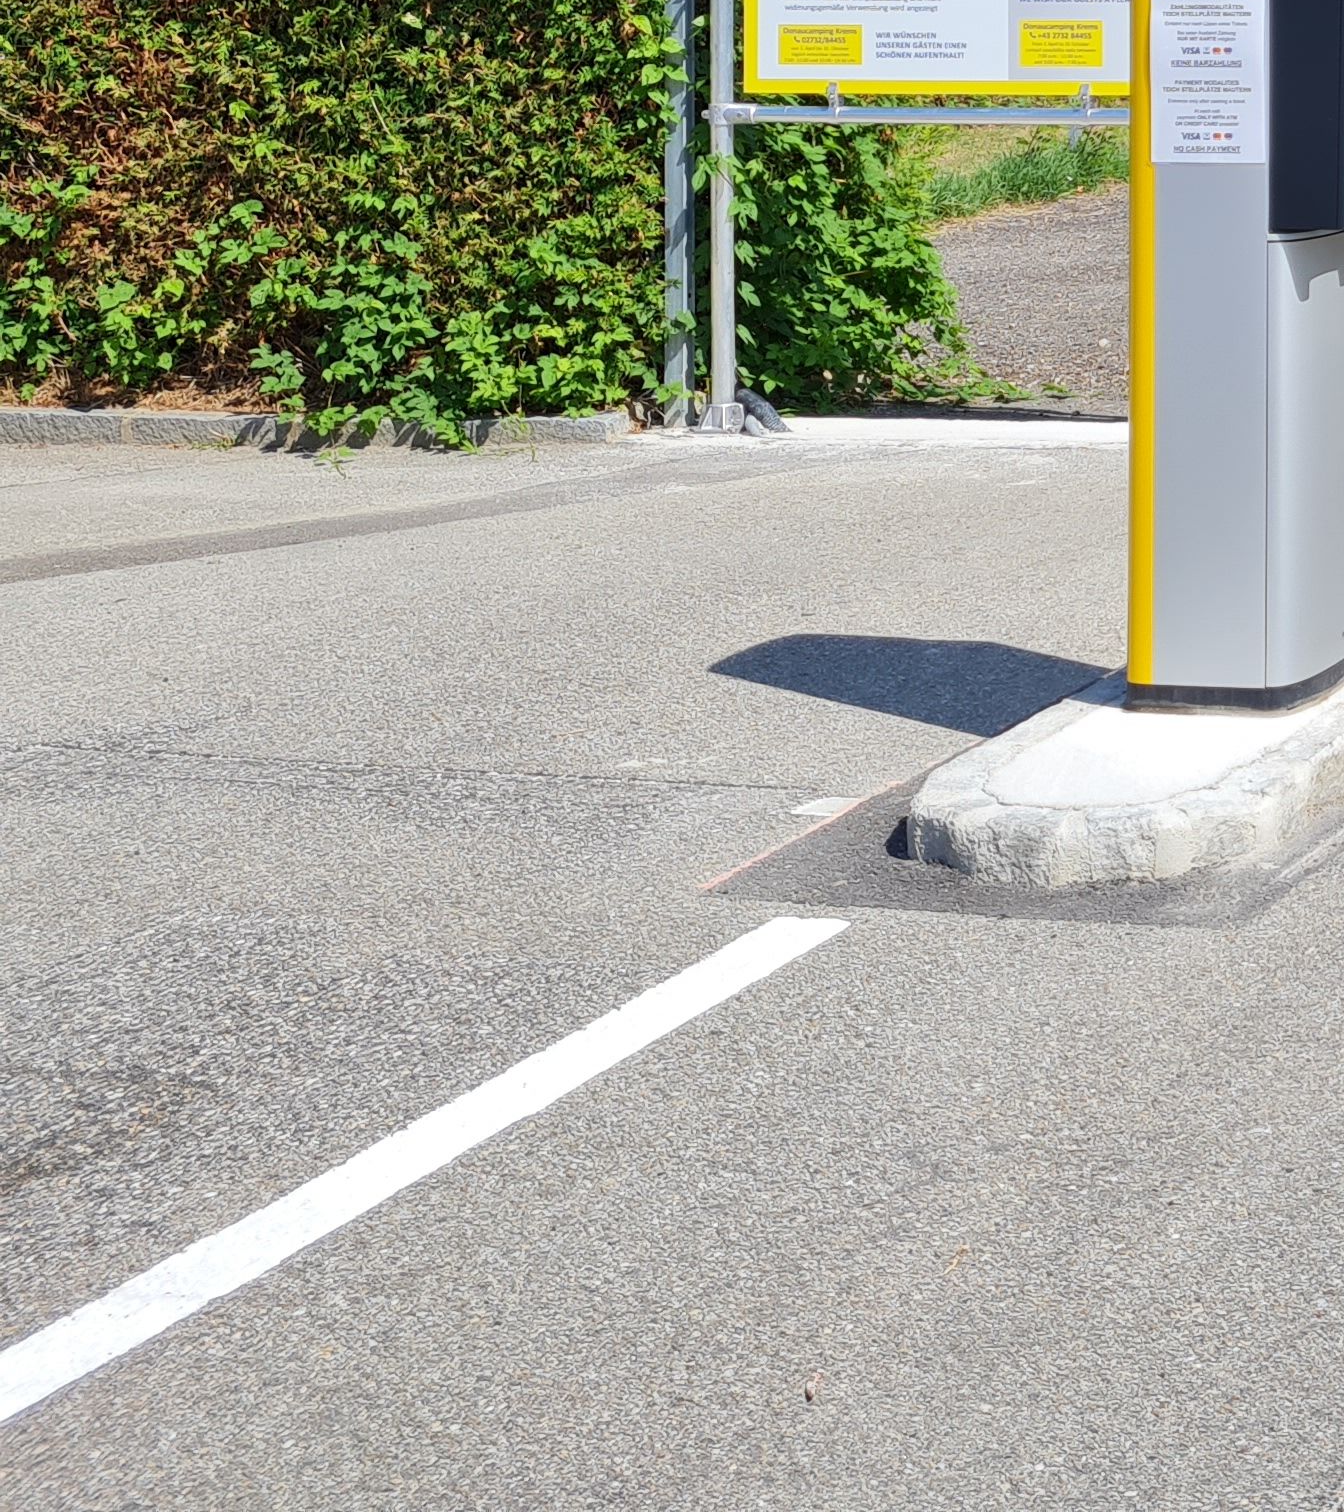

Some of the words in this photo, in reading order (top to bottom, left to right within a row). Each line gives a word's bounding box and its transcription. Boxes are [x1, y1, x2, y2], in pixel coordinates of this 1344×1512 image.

[892, 31, 937, 39] WÜNSCHEN
[875, 51, 912, 59] SCHÖNEN
[1181, 132, 1200, 140] VISA
